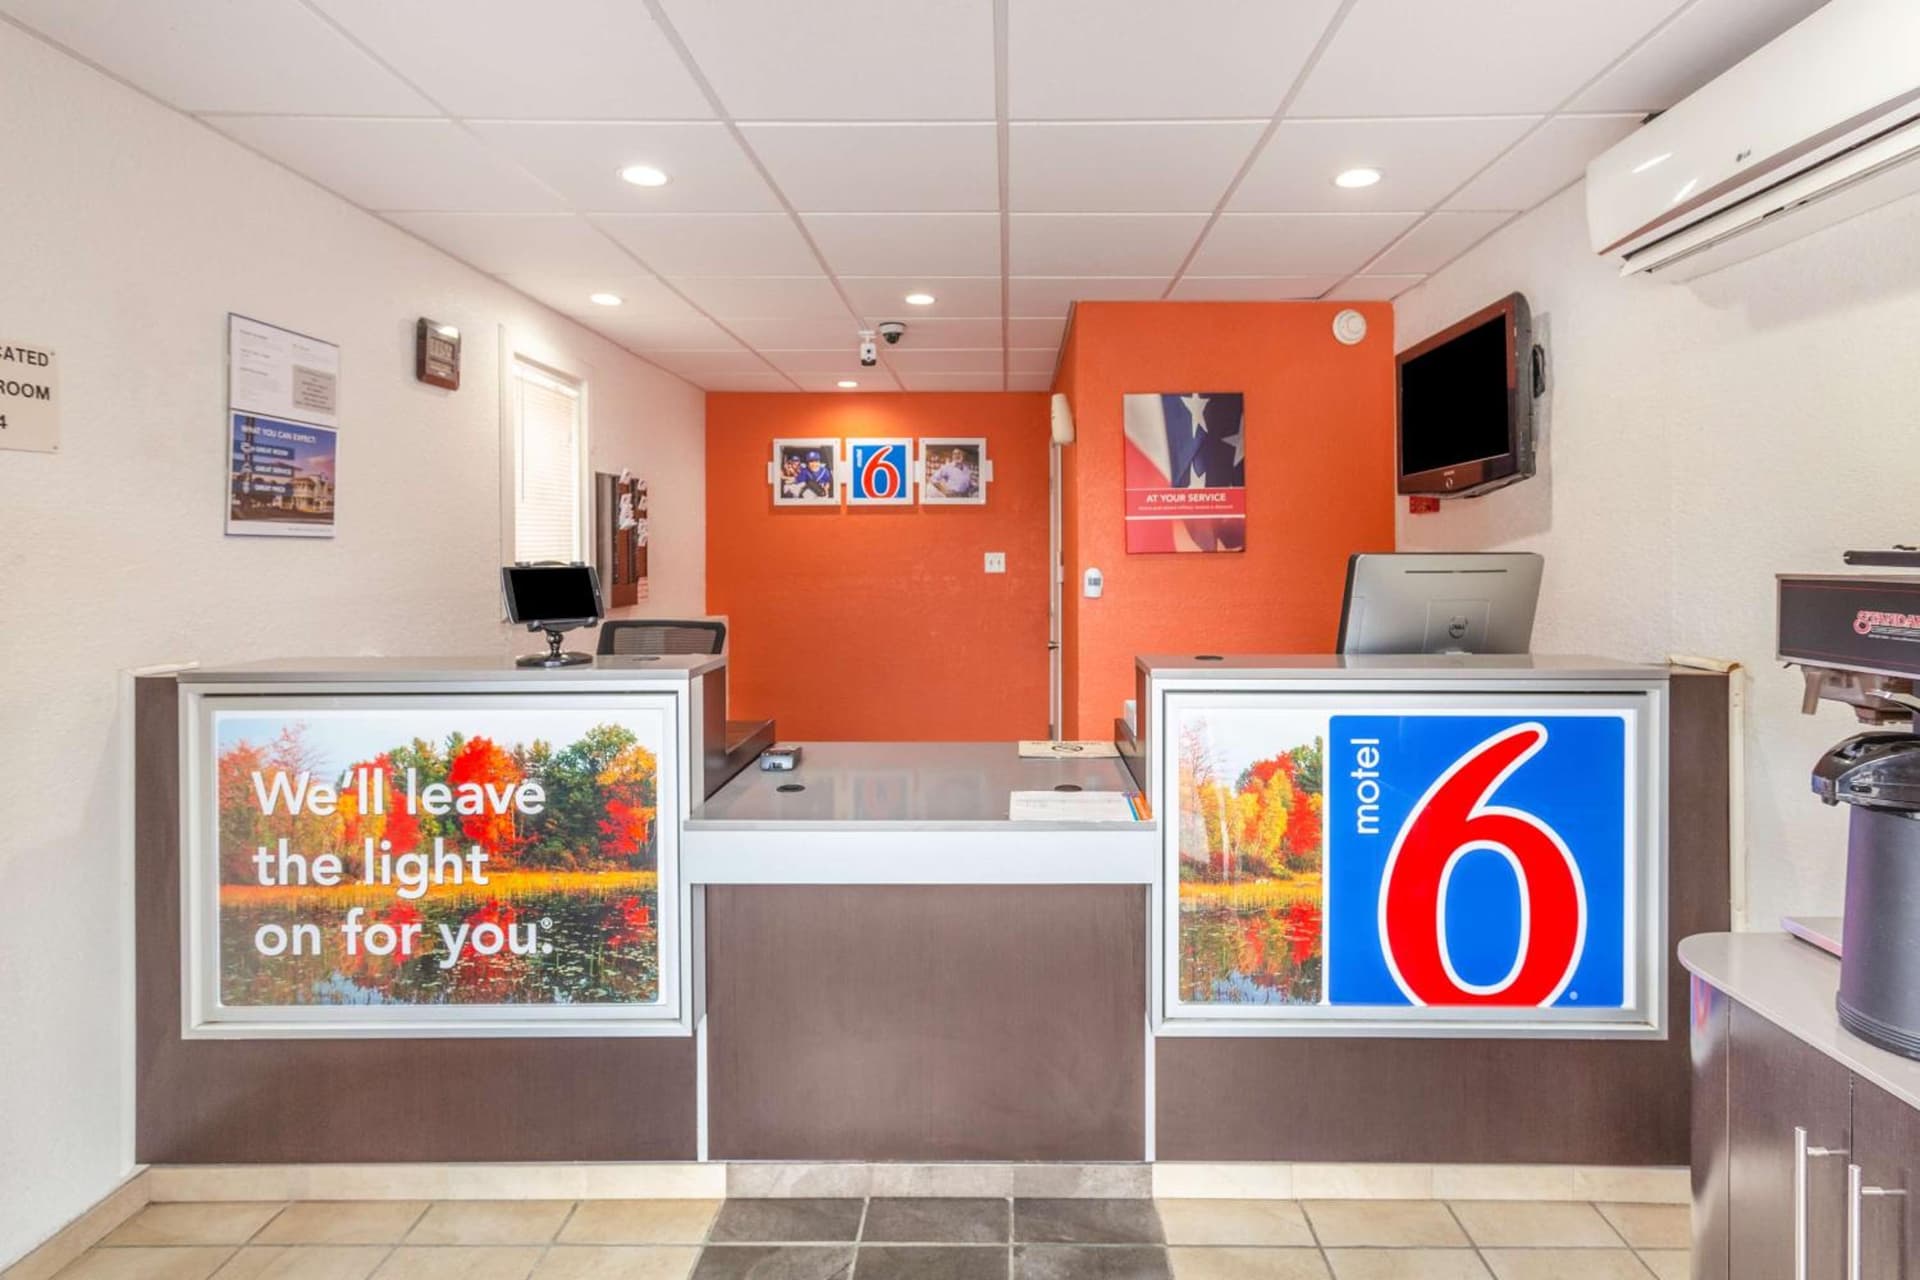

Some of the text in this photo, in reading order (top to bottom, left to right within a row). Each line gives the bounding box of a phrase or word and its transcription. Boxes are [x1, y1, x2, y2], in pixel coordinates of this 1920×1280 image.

[0, 346, 49, 367] ATED
[861, 445, 901, 499] 6
[1146, 492, 1226, 504] AT YOUR SERVICE
[252, 767, 546, 816] We'll leave
[1350, 738, 1379, 835] motel
[252, 838, 489, 899] the light
[1377, 721, 1588, 1007] 6
[254, 924, 321, 957] on
[341, 907, 423, 957] for
